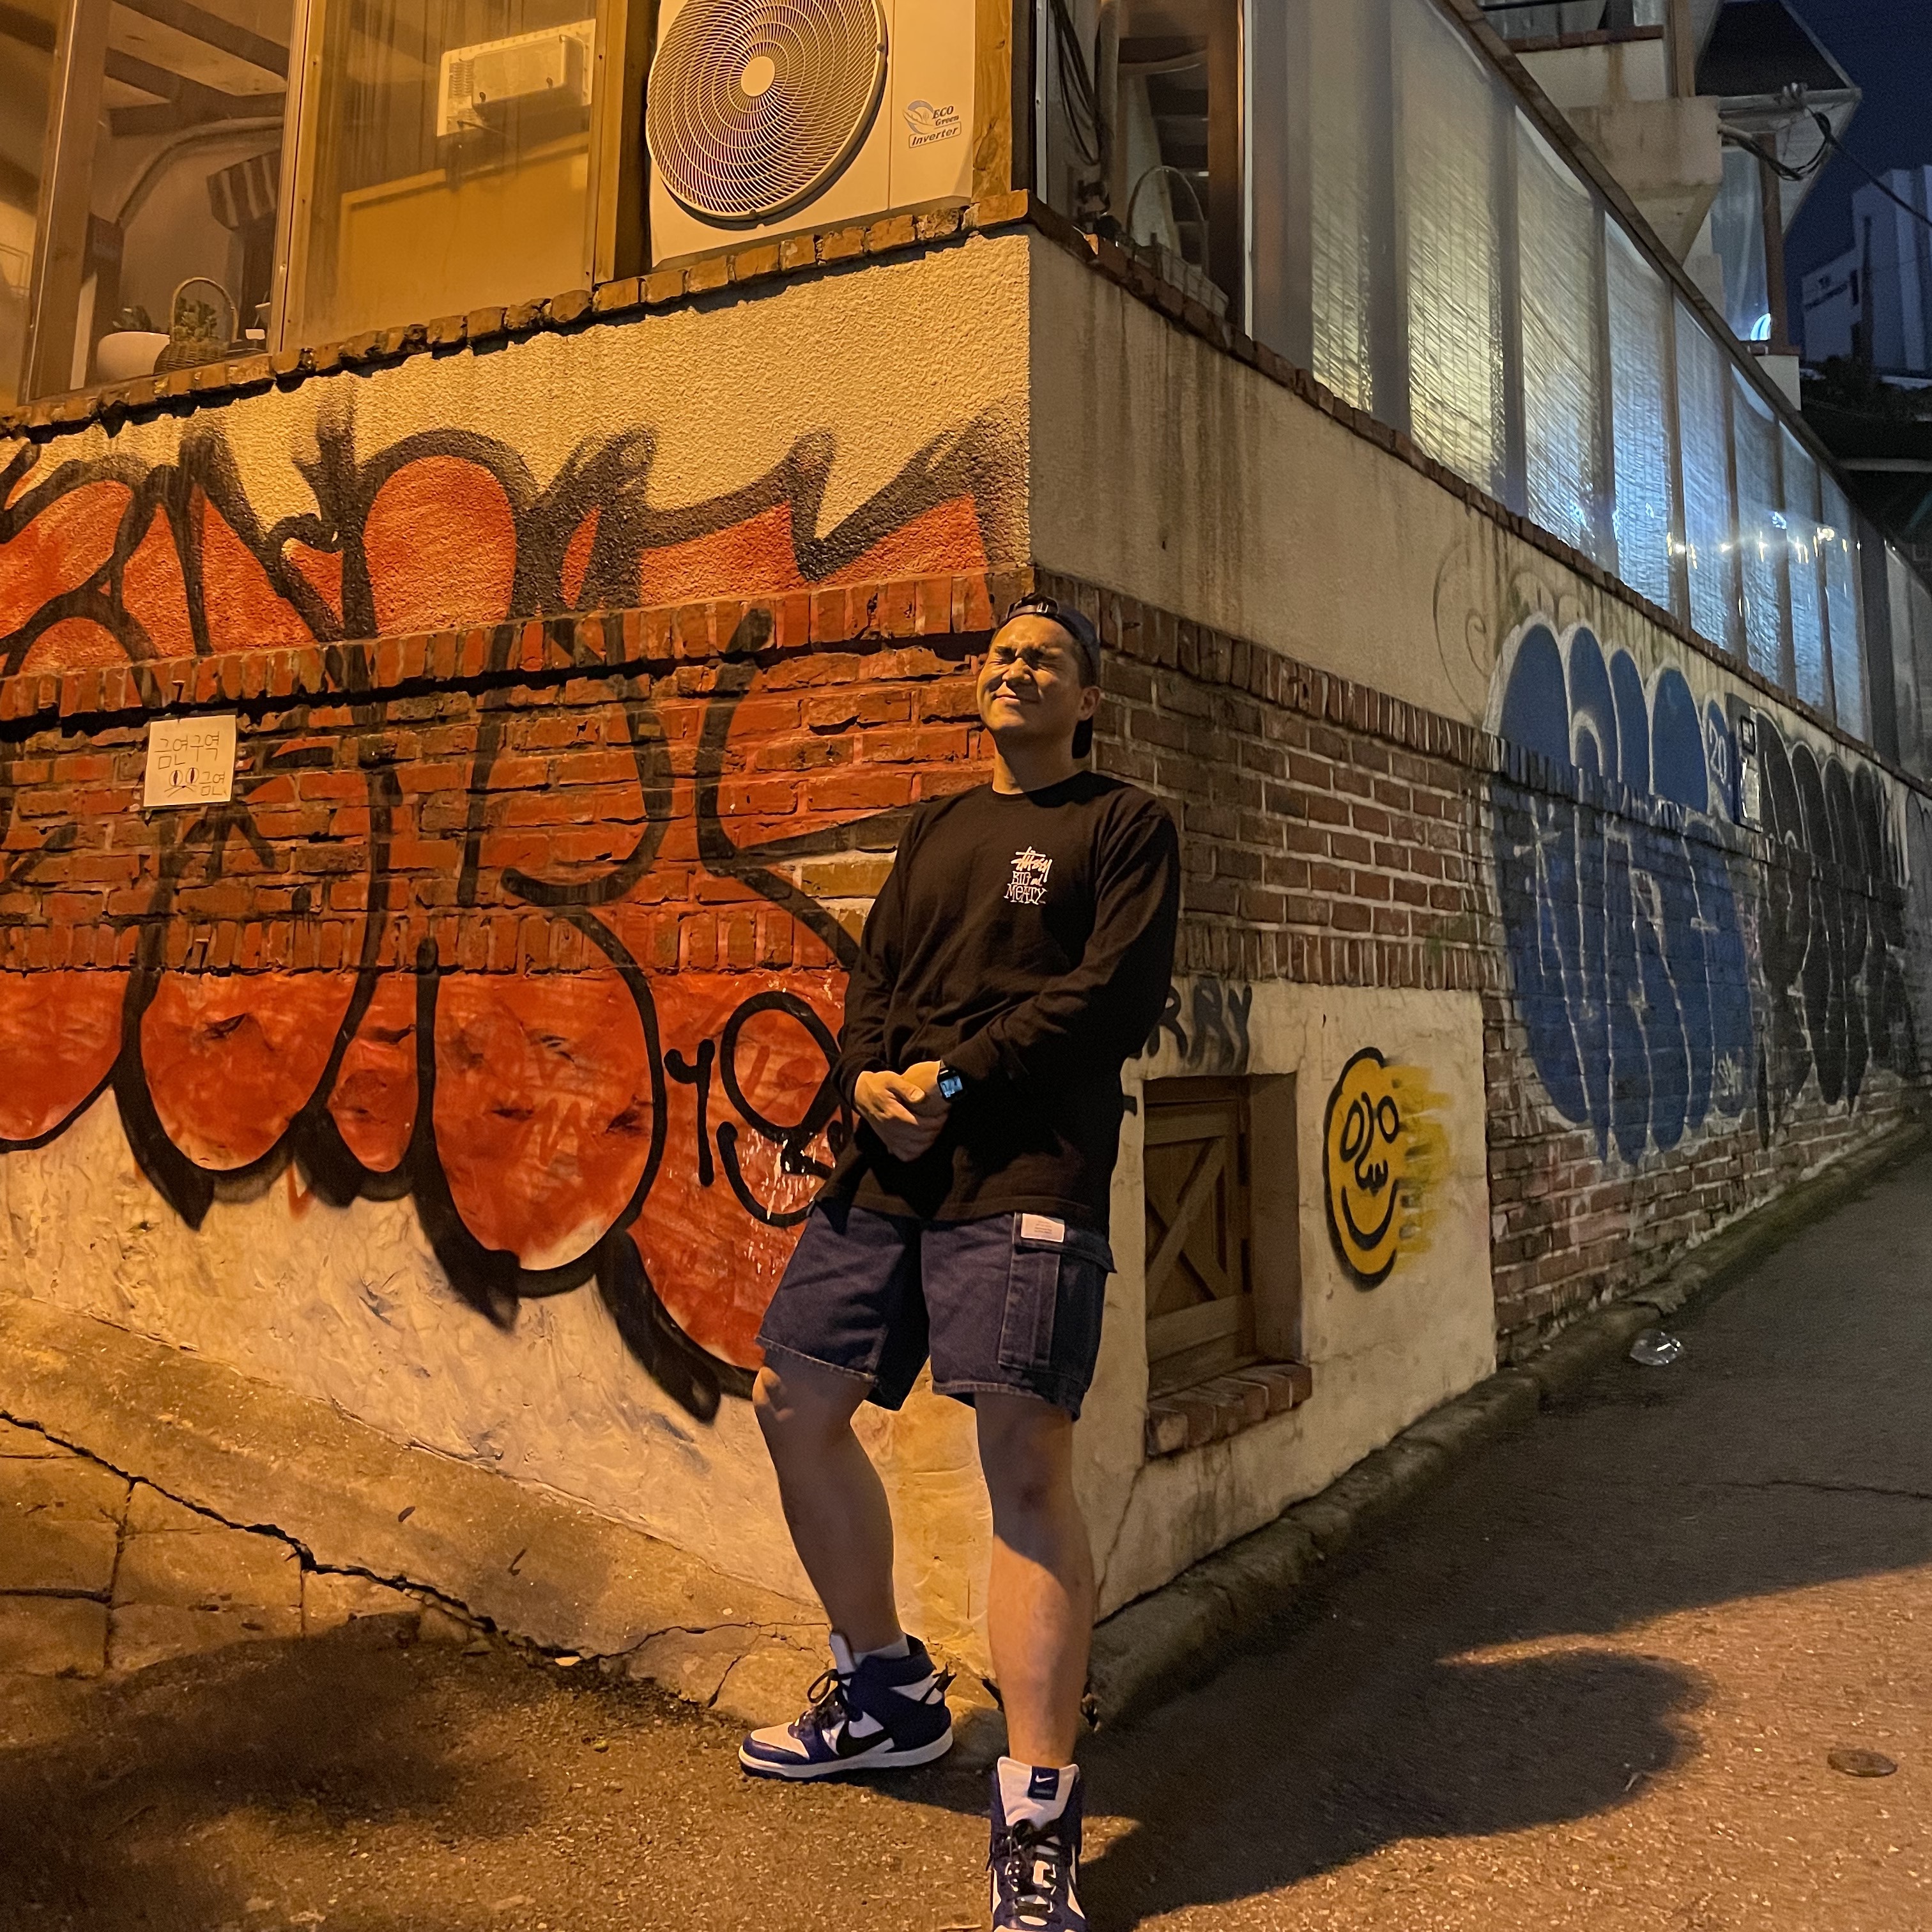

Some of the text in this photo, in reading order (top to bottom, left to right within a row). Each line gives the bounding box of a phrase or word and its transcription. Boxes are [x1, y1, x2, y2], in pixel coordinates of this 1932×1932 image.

[931, 105, 954, 119] ECO
[935, 115, 960, 126] Green
[911, 127, 959, 146] Inverter
[153, 730, 220, 770] 금연구역
[199, 770, 226, 797] 금연
[1011, 870, 1032, 886] BIG
[1127, 976, 1253, 1075] RRY
